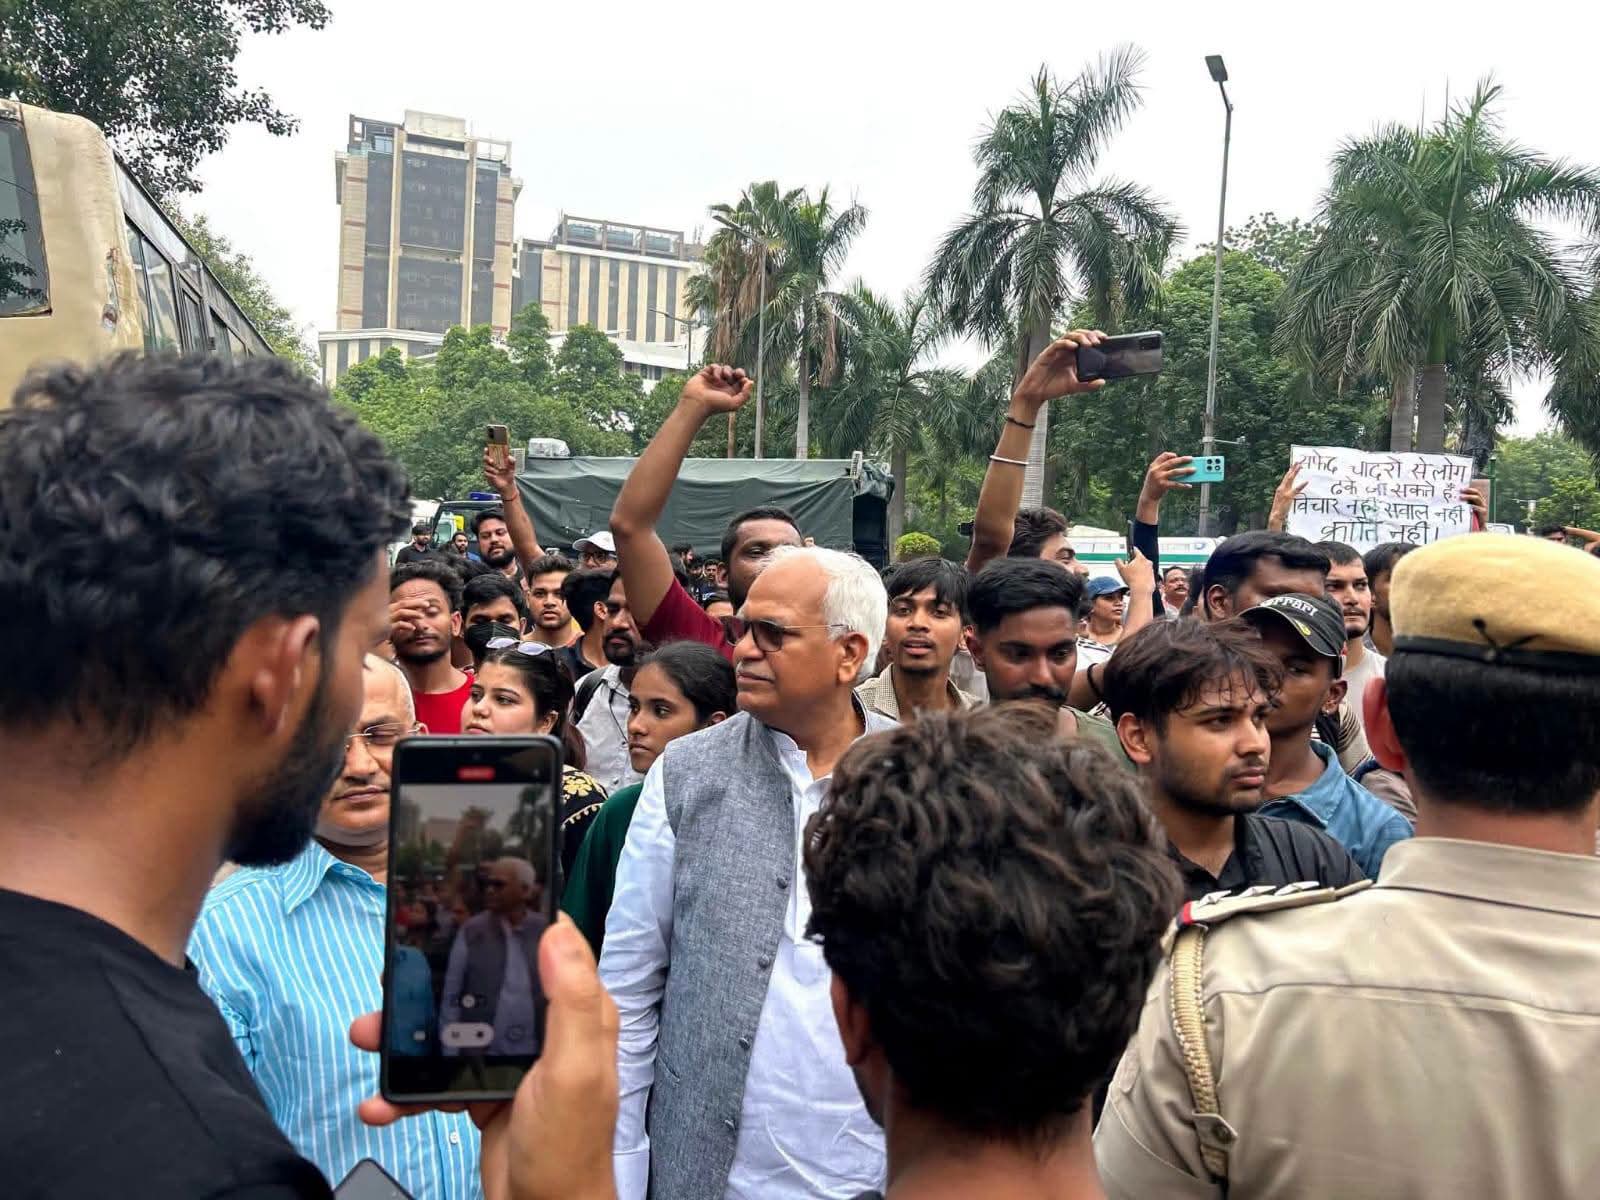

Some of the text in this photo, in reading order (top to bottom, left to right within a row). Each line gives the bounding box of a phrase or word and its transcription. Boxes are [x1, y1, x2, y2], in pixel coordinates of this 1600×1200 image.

[1411, 456, 1432, 480] से
[1433, 457, 1467, 482] लोग
[1391, 481, 1434, 498] सकते
[1293, 493, 1338, 515] विचार
[1384, 501, 1429, 520] सवाल
